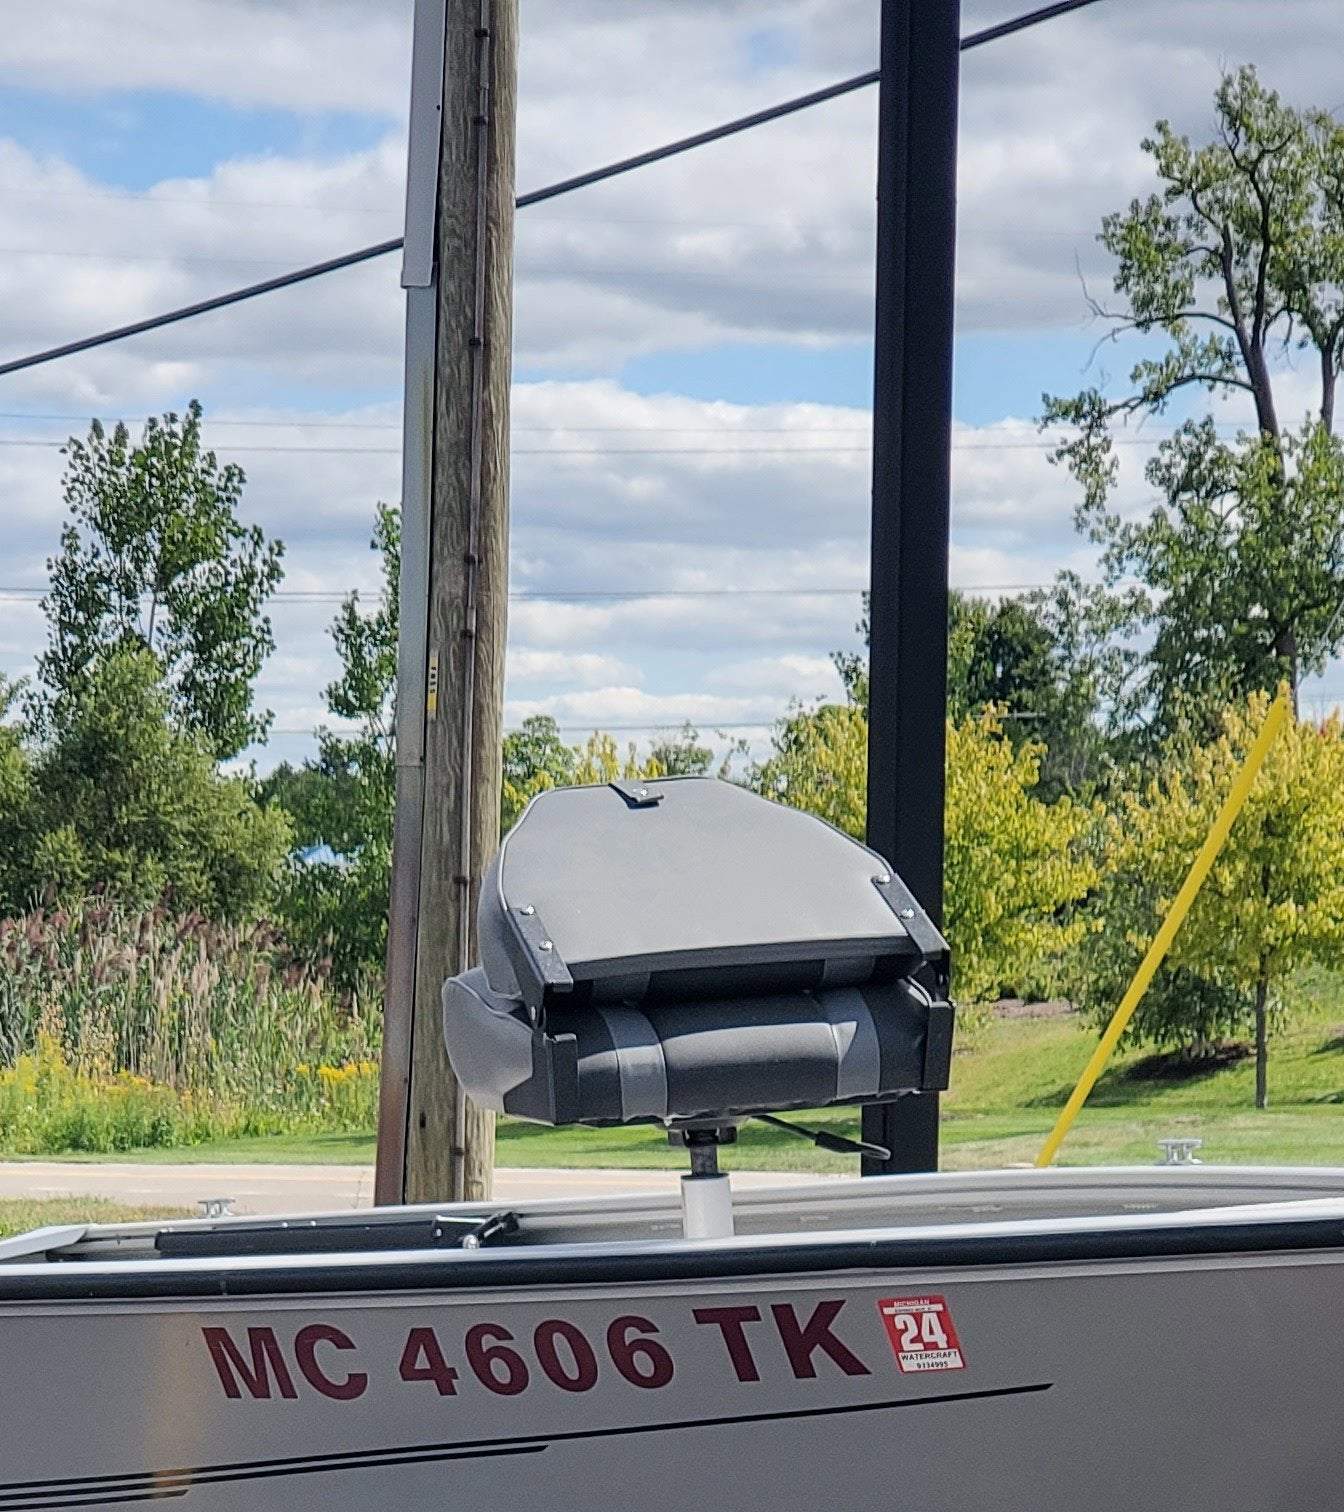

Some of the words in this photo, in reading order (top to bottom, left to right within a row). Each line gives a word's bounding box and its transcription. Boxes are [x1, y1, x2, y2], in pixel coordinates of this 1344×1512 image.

[202, 1324, 368, 1400] MC
[399, 1315, 675, 1396] 4606
[692, 1300, 873, 1382] TK
[894, 1312, 948, 1351] 24
[900, 1351, 958, 1361] WATERCRAFT
